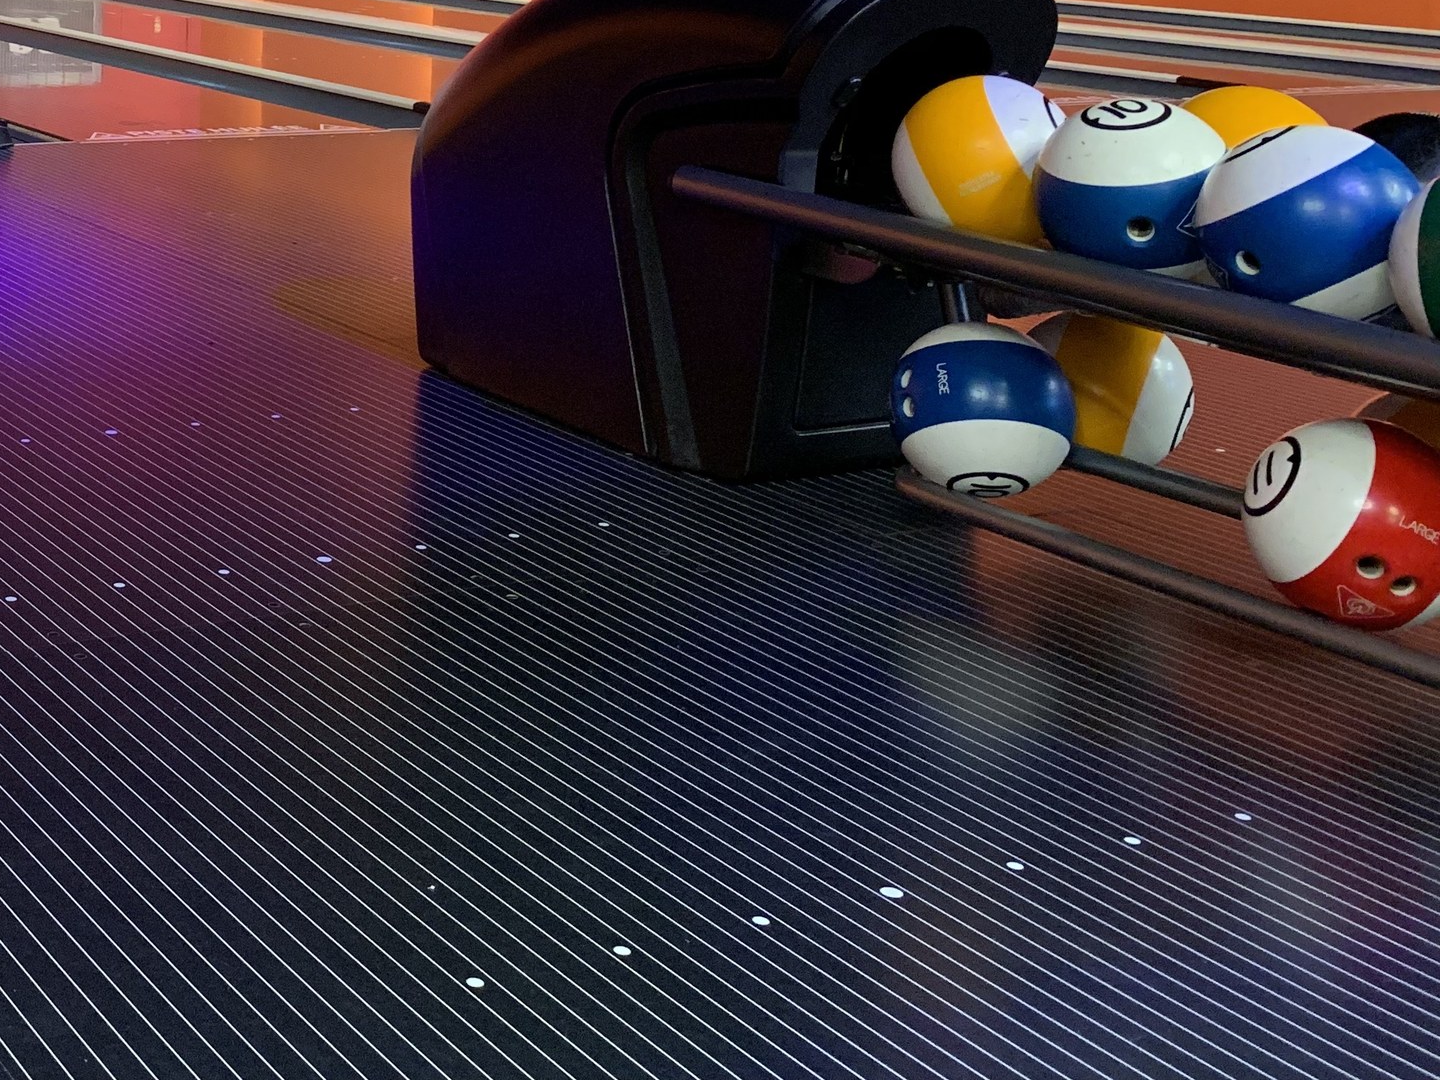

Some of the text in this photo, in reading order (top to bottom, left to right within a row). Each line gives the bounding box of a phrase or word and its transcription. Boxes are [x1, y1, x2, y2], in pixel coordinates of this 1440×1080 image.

[1098, 99, 1149, 120] 10
[935, 362, 950, 395] LARGE
[1398, 515, 1440, 545] LARGE
